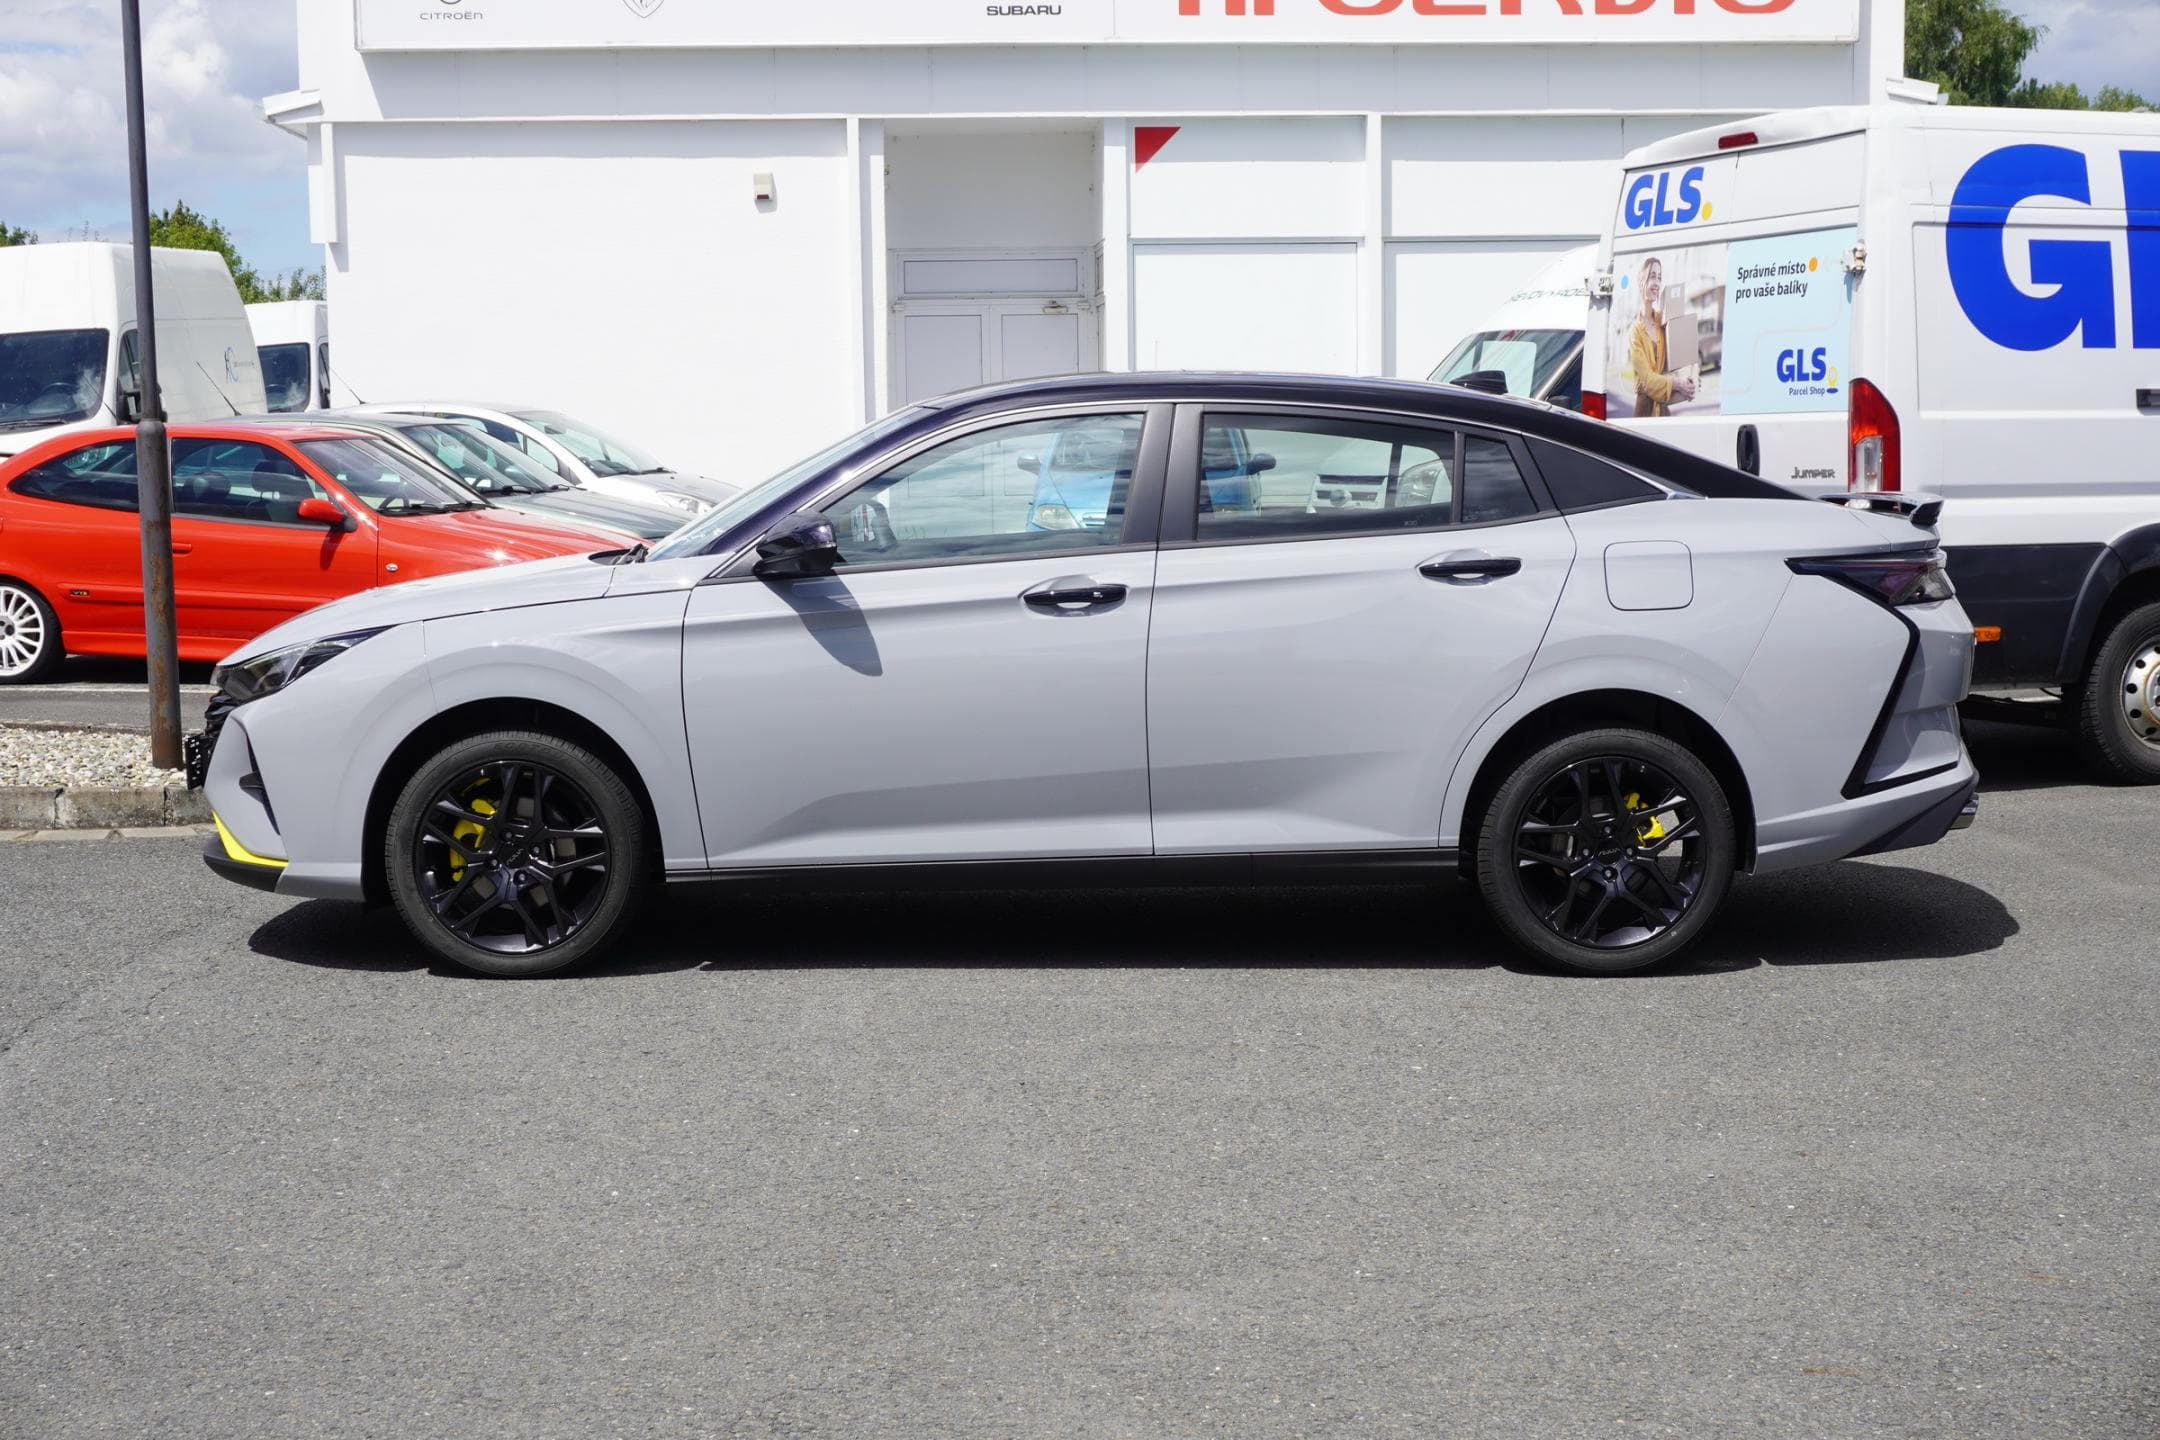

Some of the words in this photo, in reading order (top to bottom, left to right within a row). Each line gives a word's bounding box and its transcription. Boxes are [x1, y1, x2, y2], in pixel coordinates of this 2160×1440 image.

[986, 5, 1062, 16] SUBARU
[1737, 262, 1776, 283] Správné
[1778, 261, 1806, 276] místo
[1735, 288, 1752, 303] pro
[1753, 282, 1775, 298] vaše
[1777, 280, 1808, 298] balíky
[1788, 386, 1808, 396] Parcel
[1809, 386, 1826, 397] Shop
